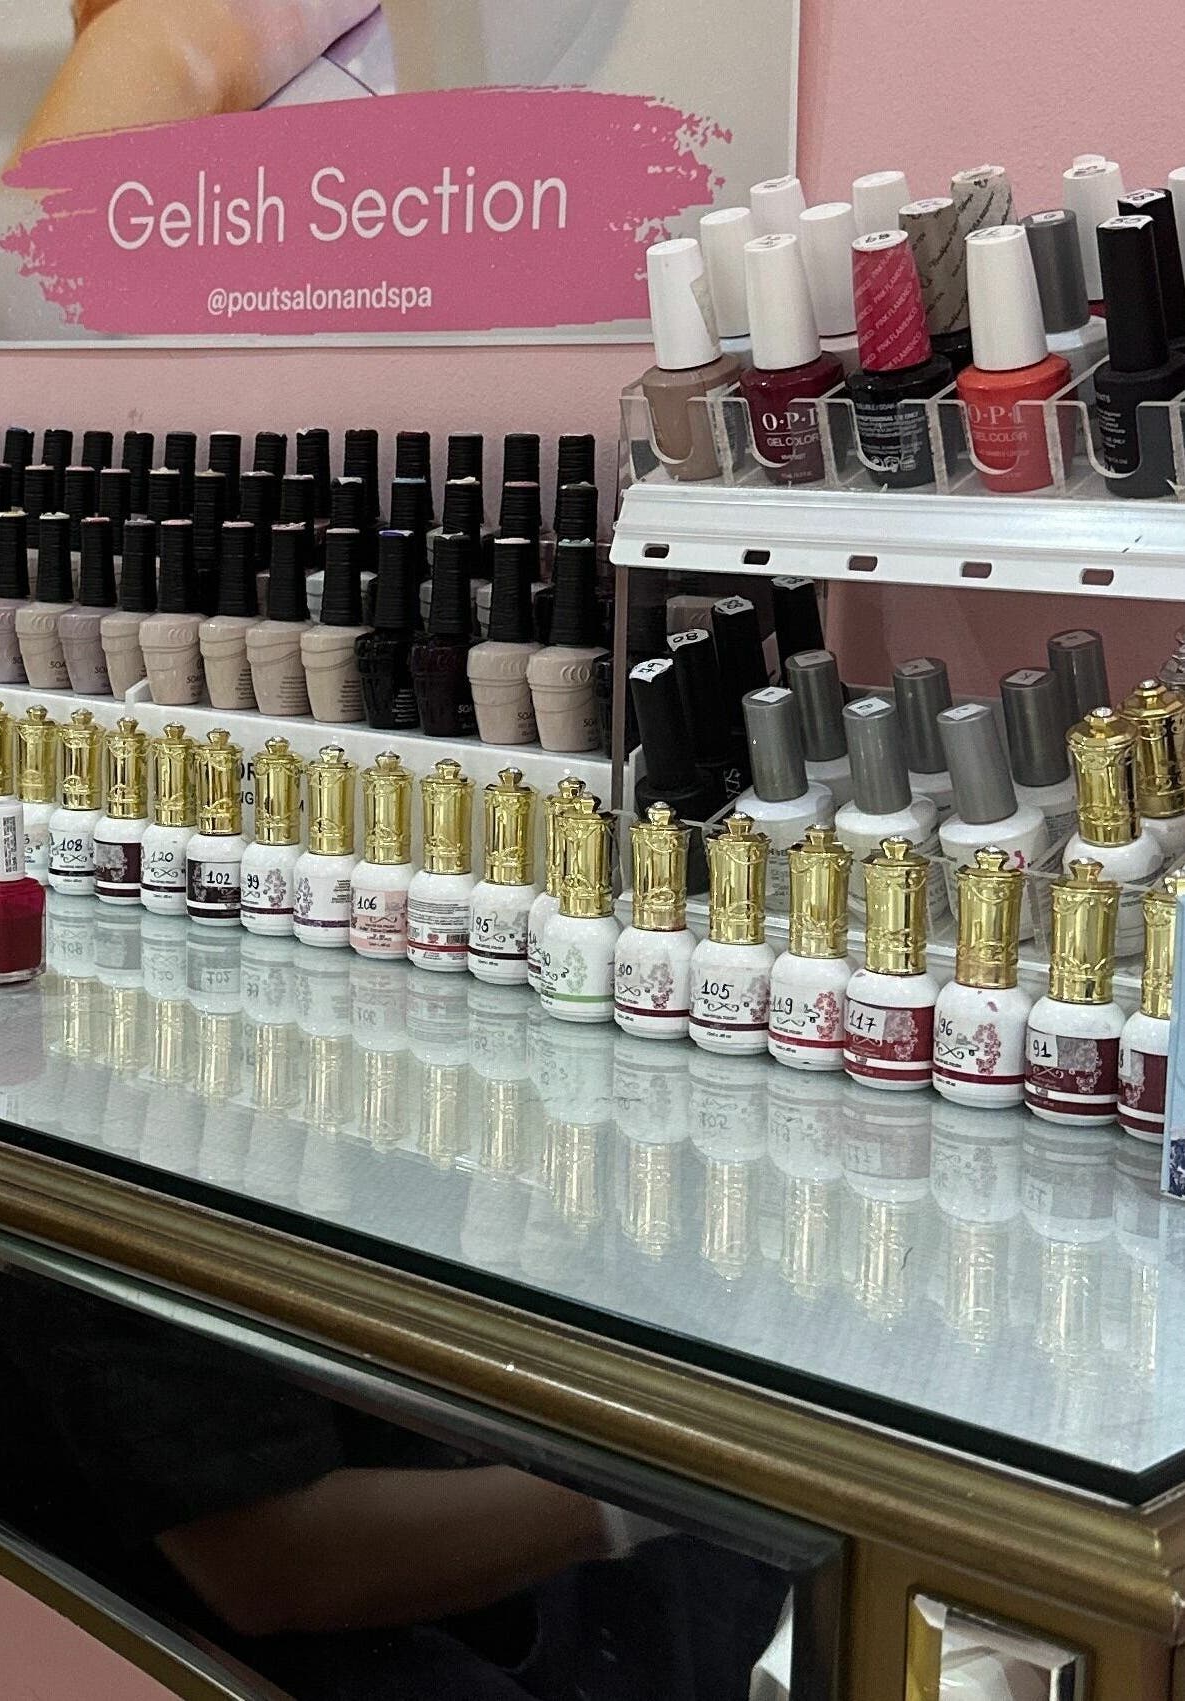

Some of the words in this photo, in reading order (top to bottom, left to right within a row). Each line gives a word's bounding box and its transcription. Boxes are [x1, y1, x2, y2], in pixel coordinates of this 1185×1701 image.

[108, 165, 285, 250] Gelish
[309, 164, 567, 243] Section
[207, 279, 433, 316] @poutsalonandspa
[61, 838, 83, 852] 108
[150, 852, 175, 864] 120
[206, 870, 232, 885] 102
[357, 895, 378, 911] 106
[475, 916, 493, 933] 95
[700, 979, 735, 1000] 105
[849, 1009, 877, 1034] 117
[1032, 1040, 1053, 1058] 91
